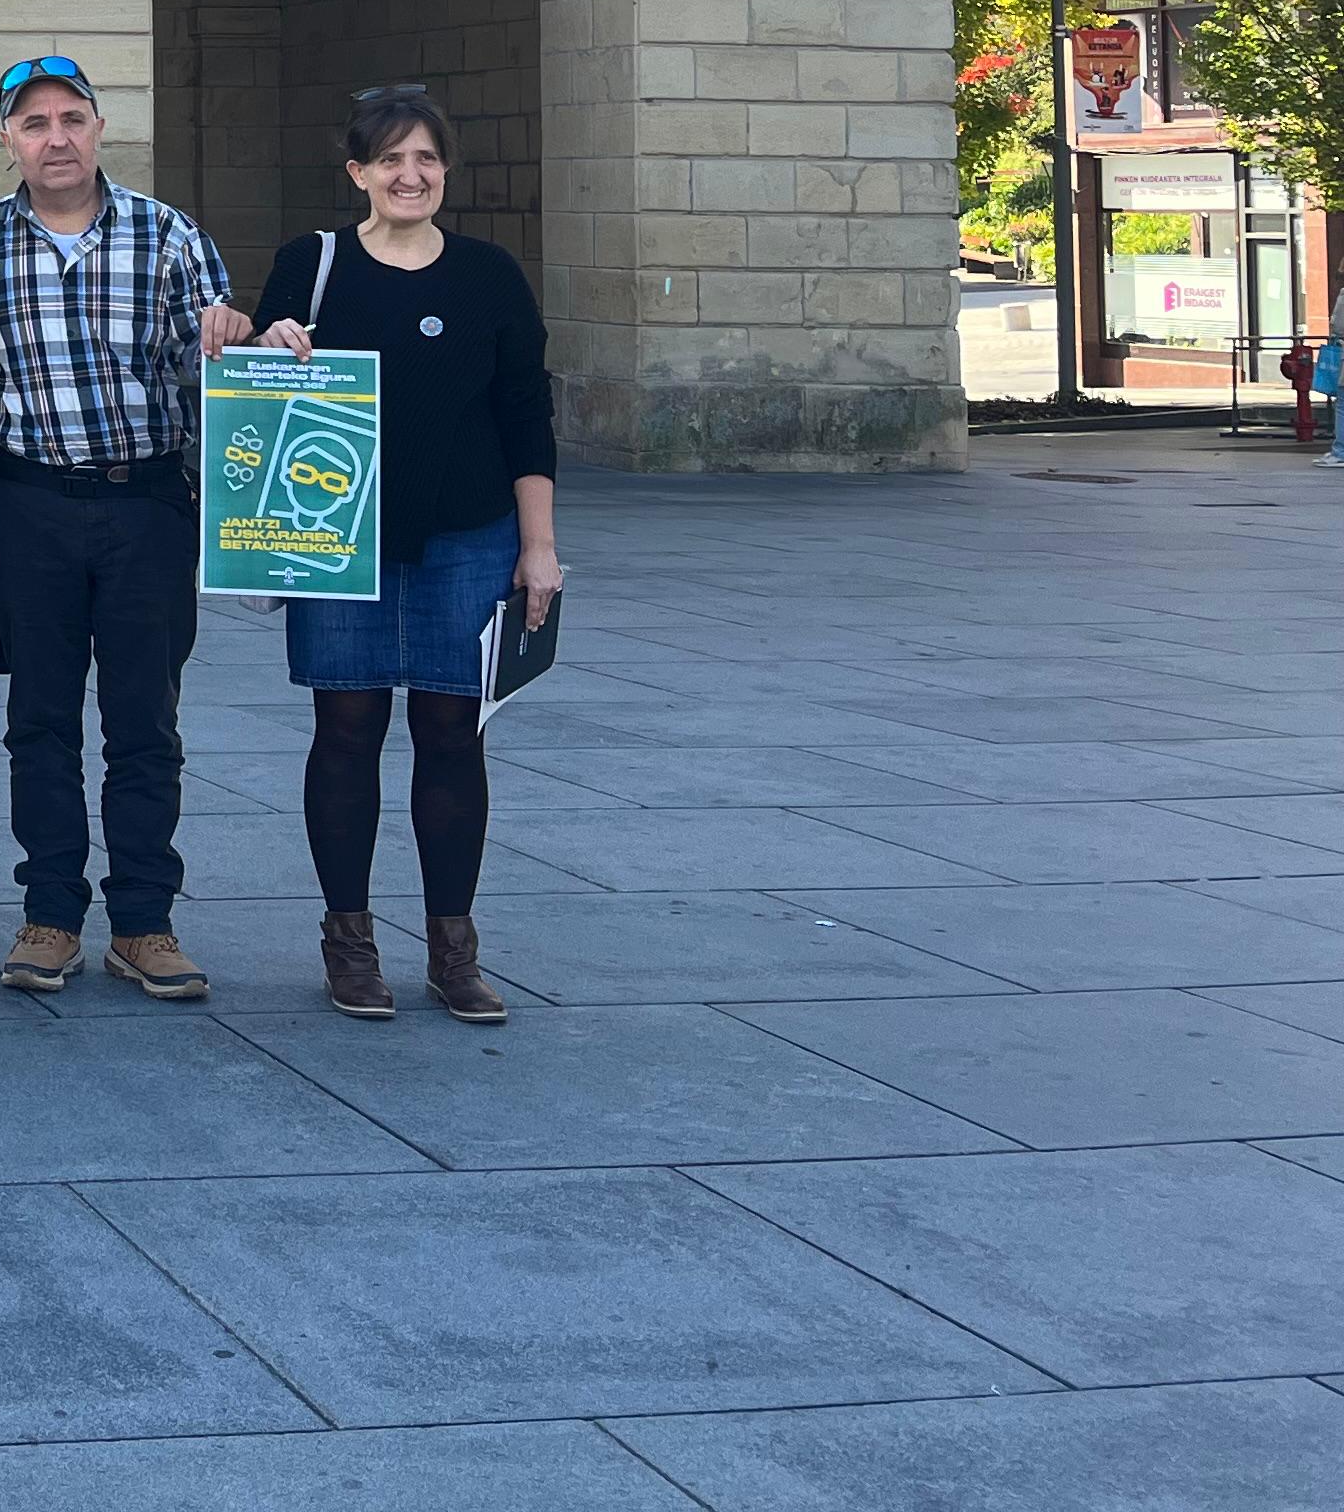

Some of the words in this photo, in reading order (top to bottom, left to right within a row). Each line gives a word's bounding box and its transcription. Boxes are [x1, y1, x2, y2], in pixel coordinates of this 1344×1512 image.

[1183, 175, 1223, 183] INTEGRALA
[247, 361, 331, 373] Euskararen
[223, 368, 308, 381] Nazioarteko
[310, 371, 357, 383] Eguna
[219, 517, 281, 529] JANTZI
[219, 528, 339, 543] EUSKARAREN
[219, 539, 358, 555] BETAURREKOAK
